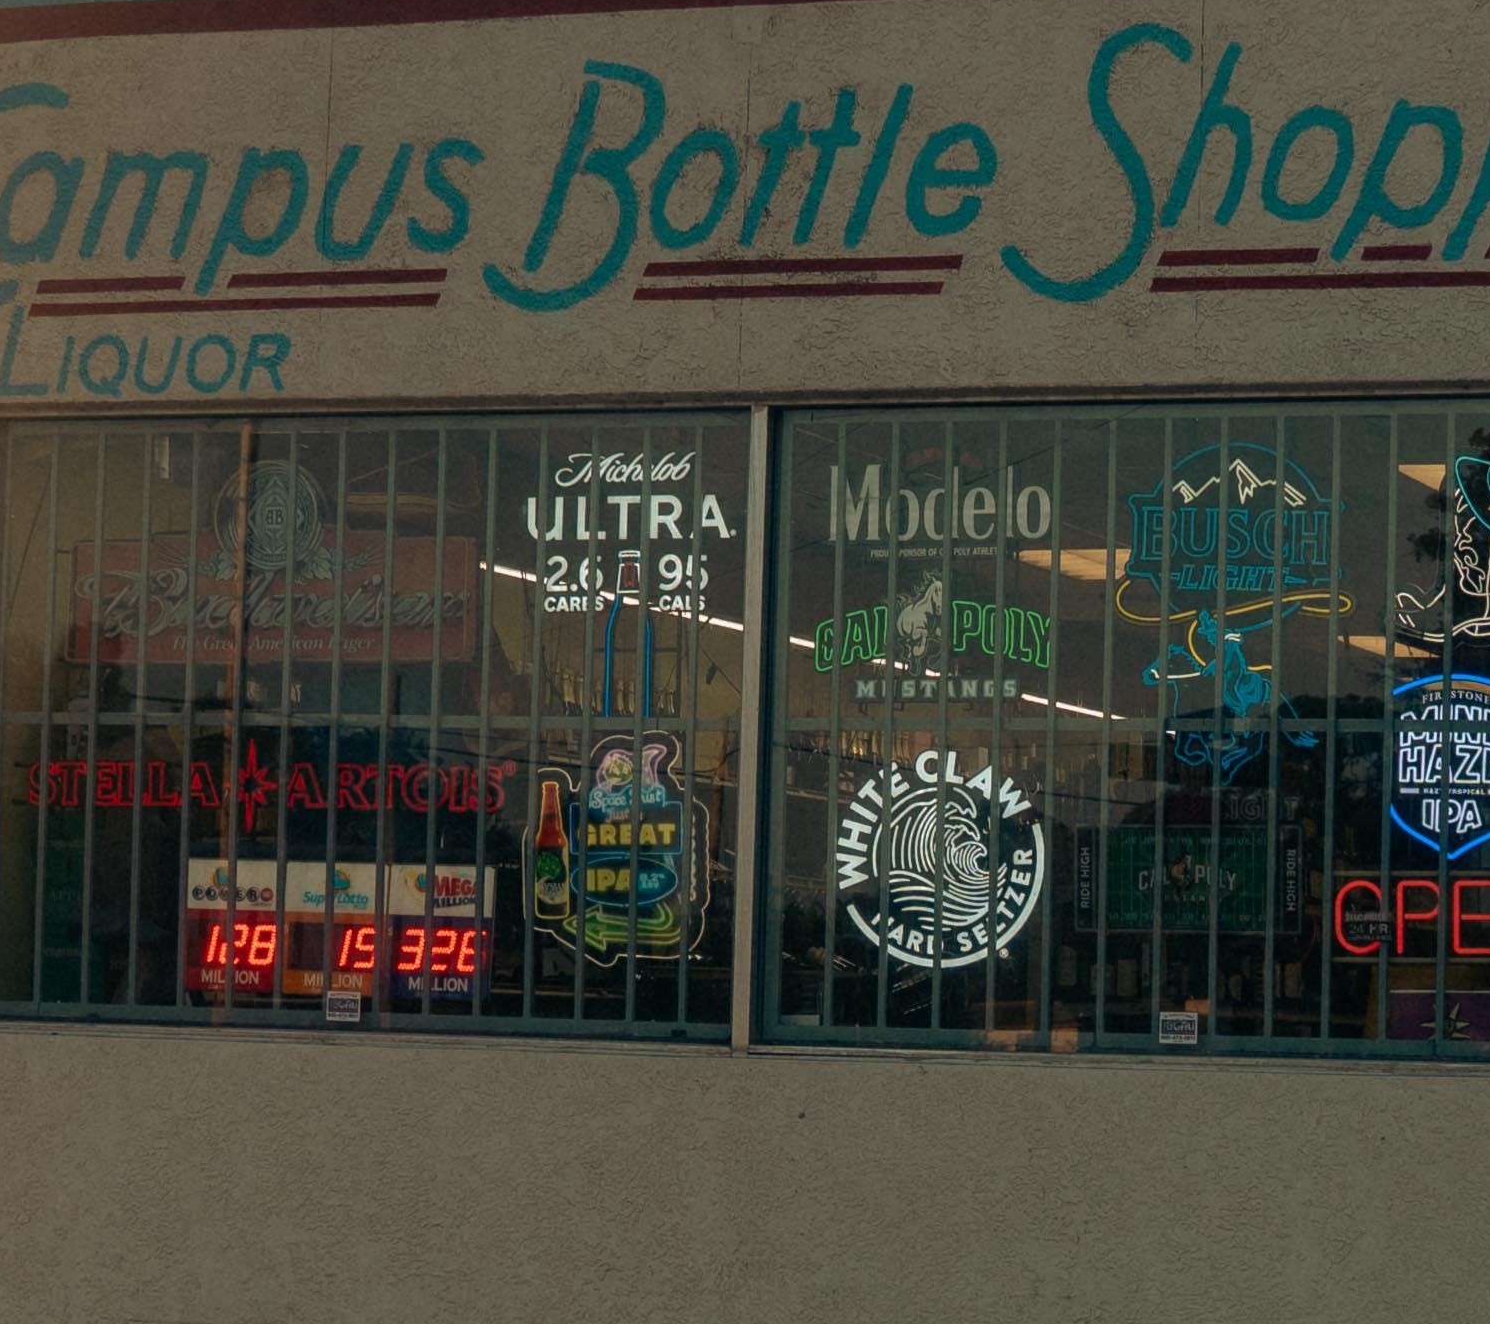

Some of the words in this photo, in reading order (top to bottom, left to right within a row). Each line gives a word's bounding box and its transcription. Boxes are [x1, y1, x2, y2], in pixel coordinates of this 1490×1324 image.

[487, 59, 1001, 311] Bottle
[527, 494, 731, 541] ULTRA
[829, 463, 1052, 543] Modelo
[1141, 505, 1332, 566] BUSCH
[546, 555, 604, 593] 2.6
[658, 554, 709, 591] 95
[1177, 563, 1289, 592] LIGHT
[814, 605, 889, 672] CAL
[952, 600, 1052, 668] POLY
[1421, 689, 1490, 705] FIRSTONE
[29, 761, 219, 807] STELLA
[287, 763, 505, 813] ARTOIS
[577, 823, 676, 846] GREAT
[836, 762, 911, 891] WHITE
[915, 749, 1032, 820] CLAW
[1079, 846, 1091, 879] HIGH
[1285, 848, 1297, 880] RIDE
[956, 847, 1034, 954] SELTZER
[1079, 880, 1091, 910] RIDE
[1285, 881, 1297, 912] HIGH
[338, 927, 377, 970] 15
[201, 969, 260, 985] MILION
